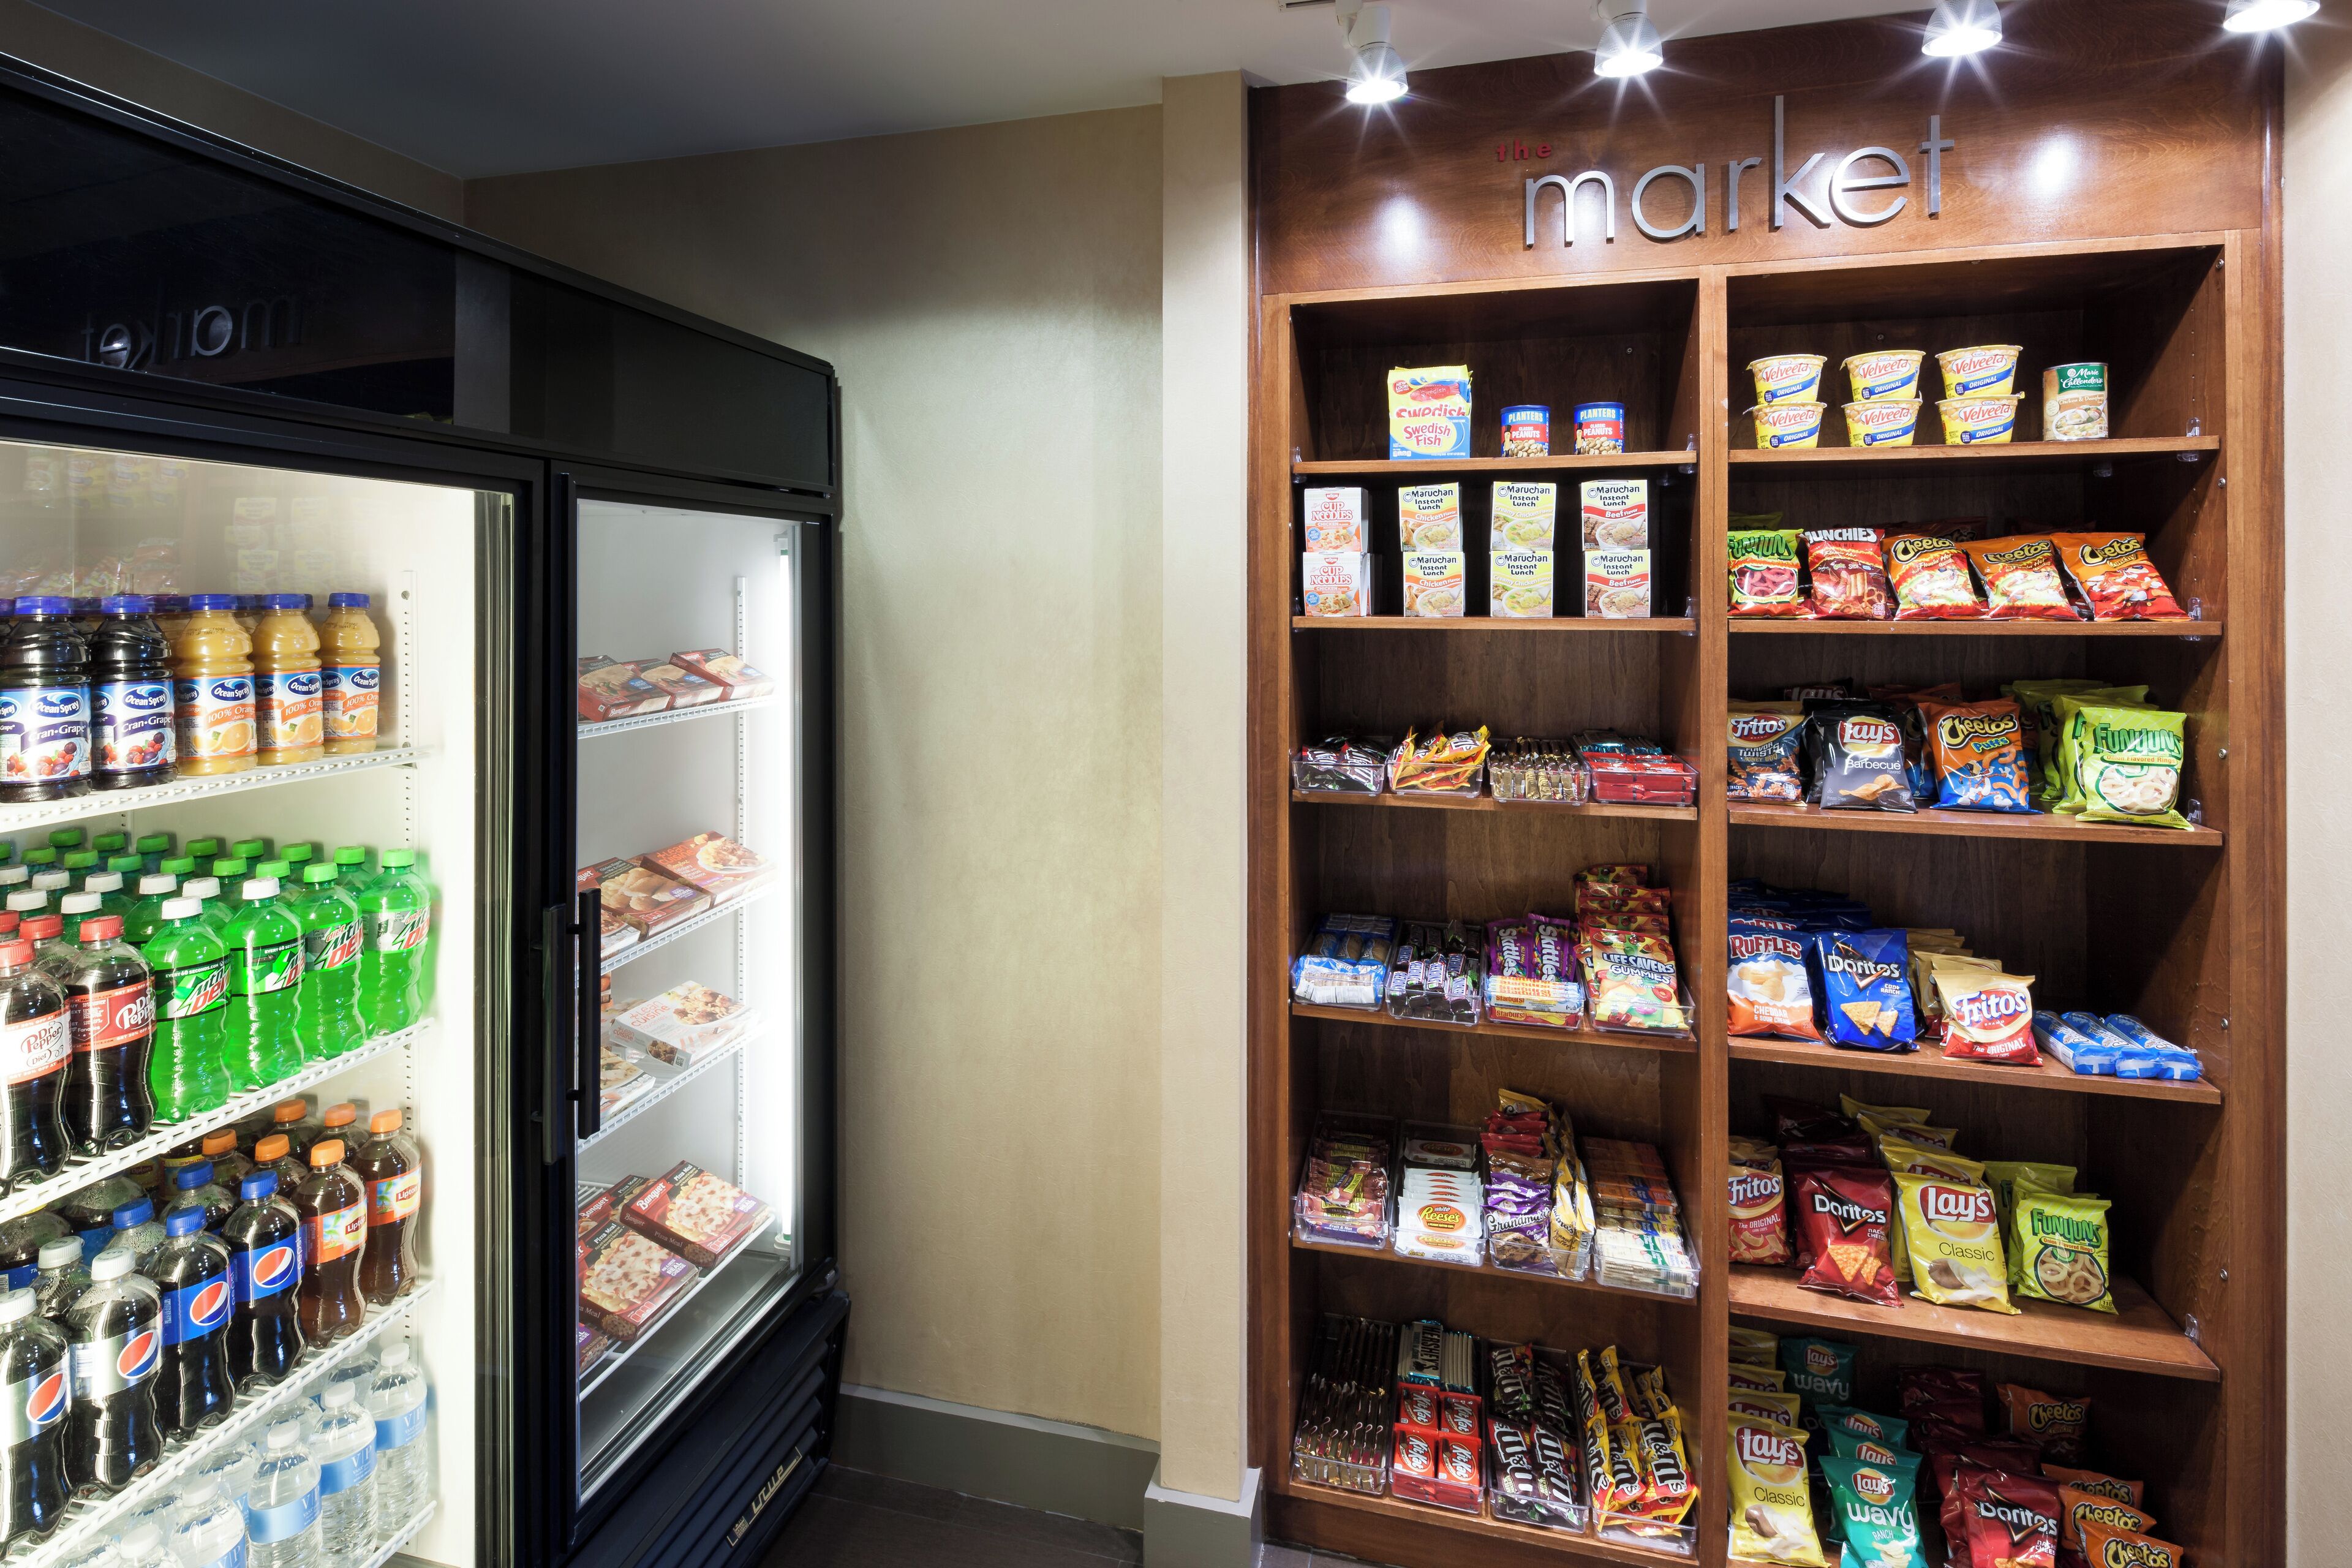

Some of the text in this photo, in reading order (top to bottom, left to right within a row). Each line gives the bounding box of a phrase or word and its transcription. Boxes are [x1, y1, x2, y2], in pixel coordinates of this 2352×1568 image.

[1496, 140, 1552, 162] the
[1526, 95, 1954, 246] market
[1765, 363, 1808, 382] Velveeta
[1862, 359, 1909, 379] Velveeta
[1955, 354, 2005, 374] Velveeta
[1777, 384, 1803, 396] ORIGINAL
[1874, 381, 1902, 393] ORIGINAL
[1969, 376, 1997, 388] ORIGINAL
[2060, 377, 2103, 388] Callender's
[1508, 412, 1543, 423] PLANTERS
[1580, 408, 1616, 420] PLANTERS
[1771, 410, 1815, 428] Velveeta
[1864, 408, 1910, 425] Velveeta
[1963, 404, 2011, 423] Velveeta
[1403, 423, 1450, 439] Swedish
[1512, 430, 1540, 439] PEANUTS
[1583, 428, 1613, 436] PEANUTS
[1784, 431, 1808, 441] ORIGINAL
[1876, 430, 1902, 440] ORIGINAL
[1976, 426, 2004, 437] ORIGINAL
[1414, 434, 1441, 446] Fish
[1411, 489, 1453, 497] Maruchan
[1507, 486, 1550, 494] Maruchan
[1321, 502, 1344, 511] CUP
[1311, 510, 1353, 521] NOODLES
[1310, 575, 1352, 585] NOODLES
[1319, 567, 1343, 576] CUP
[290, 680, 320, 692] Ocean Spray
[353, 677, 369, 686] Ocean
[125, 693, 167, 706] Ocean Spray
[214, 685, 251, 698] Ocean Spray
[59, 699, 80, 714] Spray
[285, 702, 307, 716] 100%
[347, 696, 365, 707] 100%
[208, 706, 255, 723] 100% Orange
[608, 706, 631, 717] Banquet
[1730, 715, 1786, 738] Fritos
[1844, 722, 1896, 744] Lay's
[1941, 714, 2016, 745] Cheetos
[1971, 737, 2010, 753] Puffs
[2094, 723, 2182, 760] FUNYUNS
[1847, 758, 1901, 770] Barbecue
[1498, 928, 1516, 977] Skittles
[1538, 924, 1561, 982] Skittles
[1730, 935, 1801, 959] RUFFLES
[189, 963, 219, 975] SECONDS.COM
[1603, 952, 1674, 973] LIFE SAVERS
[1828, 956, 1901, 978] Doritos
[1611, 965, 1671, 984] GUMMIES
[631, 1005, 671, 1028] cuisine
[637, 1000, 663, 1016] Lean
[1754, 1005, 1788, 1019] CHEDDAR
[1950, 990, 2028, 1028] Fritos
[27, 1026, 61, 1054] Pepper
[39, 1026, 53, 1039] Dr
[613, 1029, 634, 1041] cuisine
[1973, 1036, 2027, 1054] The ORIGINAL
[32, 1054, 47, 1065] Diet
[674, 1164, 694, 1182] Pizza Meal
[396, 1185, 418, 1201] Lipton
[636, 1182, 666, 1210] Banquet
[1728, 1175, 1780, 1205] Fritos
[579, 1196, 609, 1219] Banquet
[1814, 1194, 1887, 1223] Doritos
[1928, 1185, 1991, 1222] Lay's
[624, 1213, 646, 1226] Banquet
[1420, 1207, 1461, 1223] Reese's
[1749, 1213, 1781, 1229] ORIGINAL
[345, 1214, 366, 1234] Lipton
[2030, 1208, 2103, 1247] FUNYUNS
[594, 1223, 617, 1244] Pizza Meal
[654, 1231, 684, 1247] Pizza Meal
[1939, 1242, 1995, 1262] Classic
[667, 1262, 684, 1275] REAL
[1421, 1325, 1441, 1371] HERSHEY'S
[1794, 1373, 1850, 1401] wavy
[1413, 1392, 1431, 1423] KitKat
[1453, 1401, 1471, 1433] KitKat
[2029, 1404, 2084, 1431] Cheetos
[1408, 1435, 1427, 1470] KitKat
[1743, 1427, 1800, 1465] Lay's
[1452, 1444, 1472, 1479] KitKat
[1754, 1487, 1806, 1507] Classic
[1846, 1502, 1917, 1536] wavy
[1978, 1501, 2057, 1536] Doritos
[1872, 1530, 1894, 1541] RANCH
